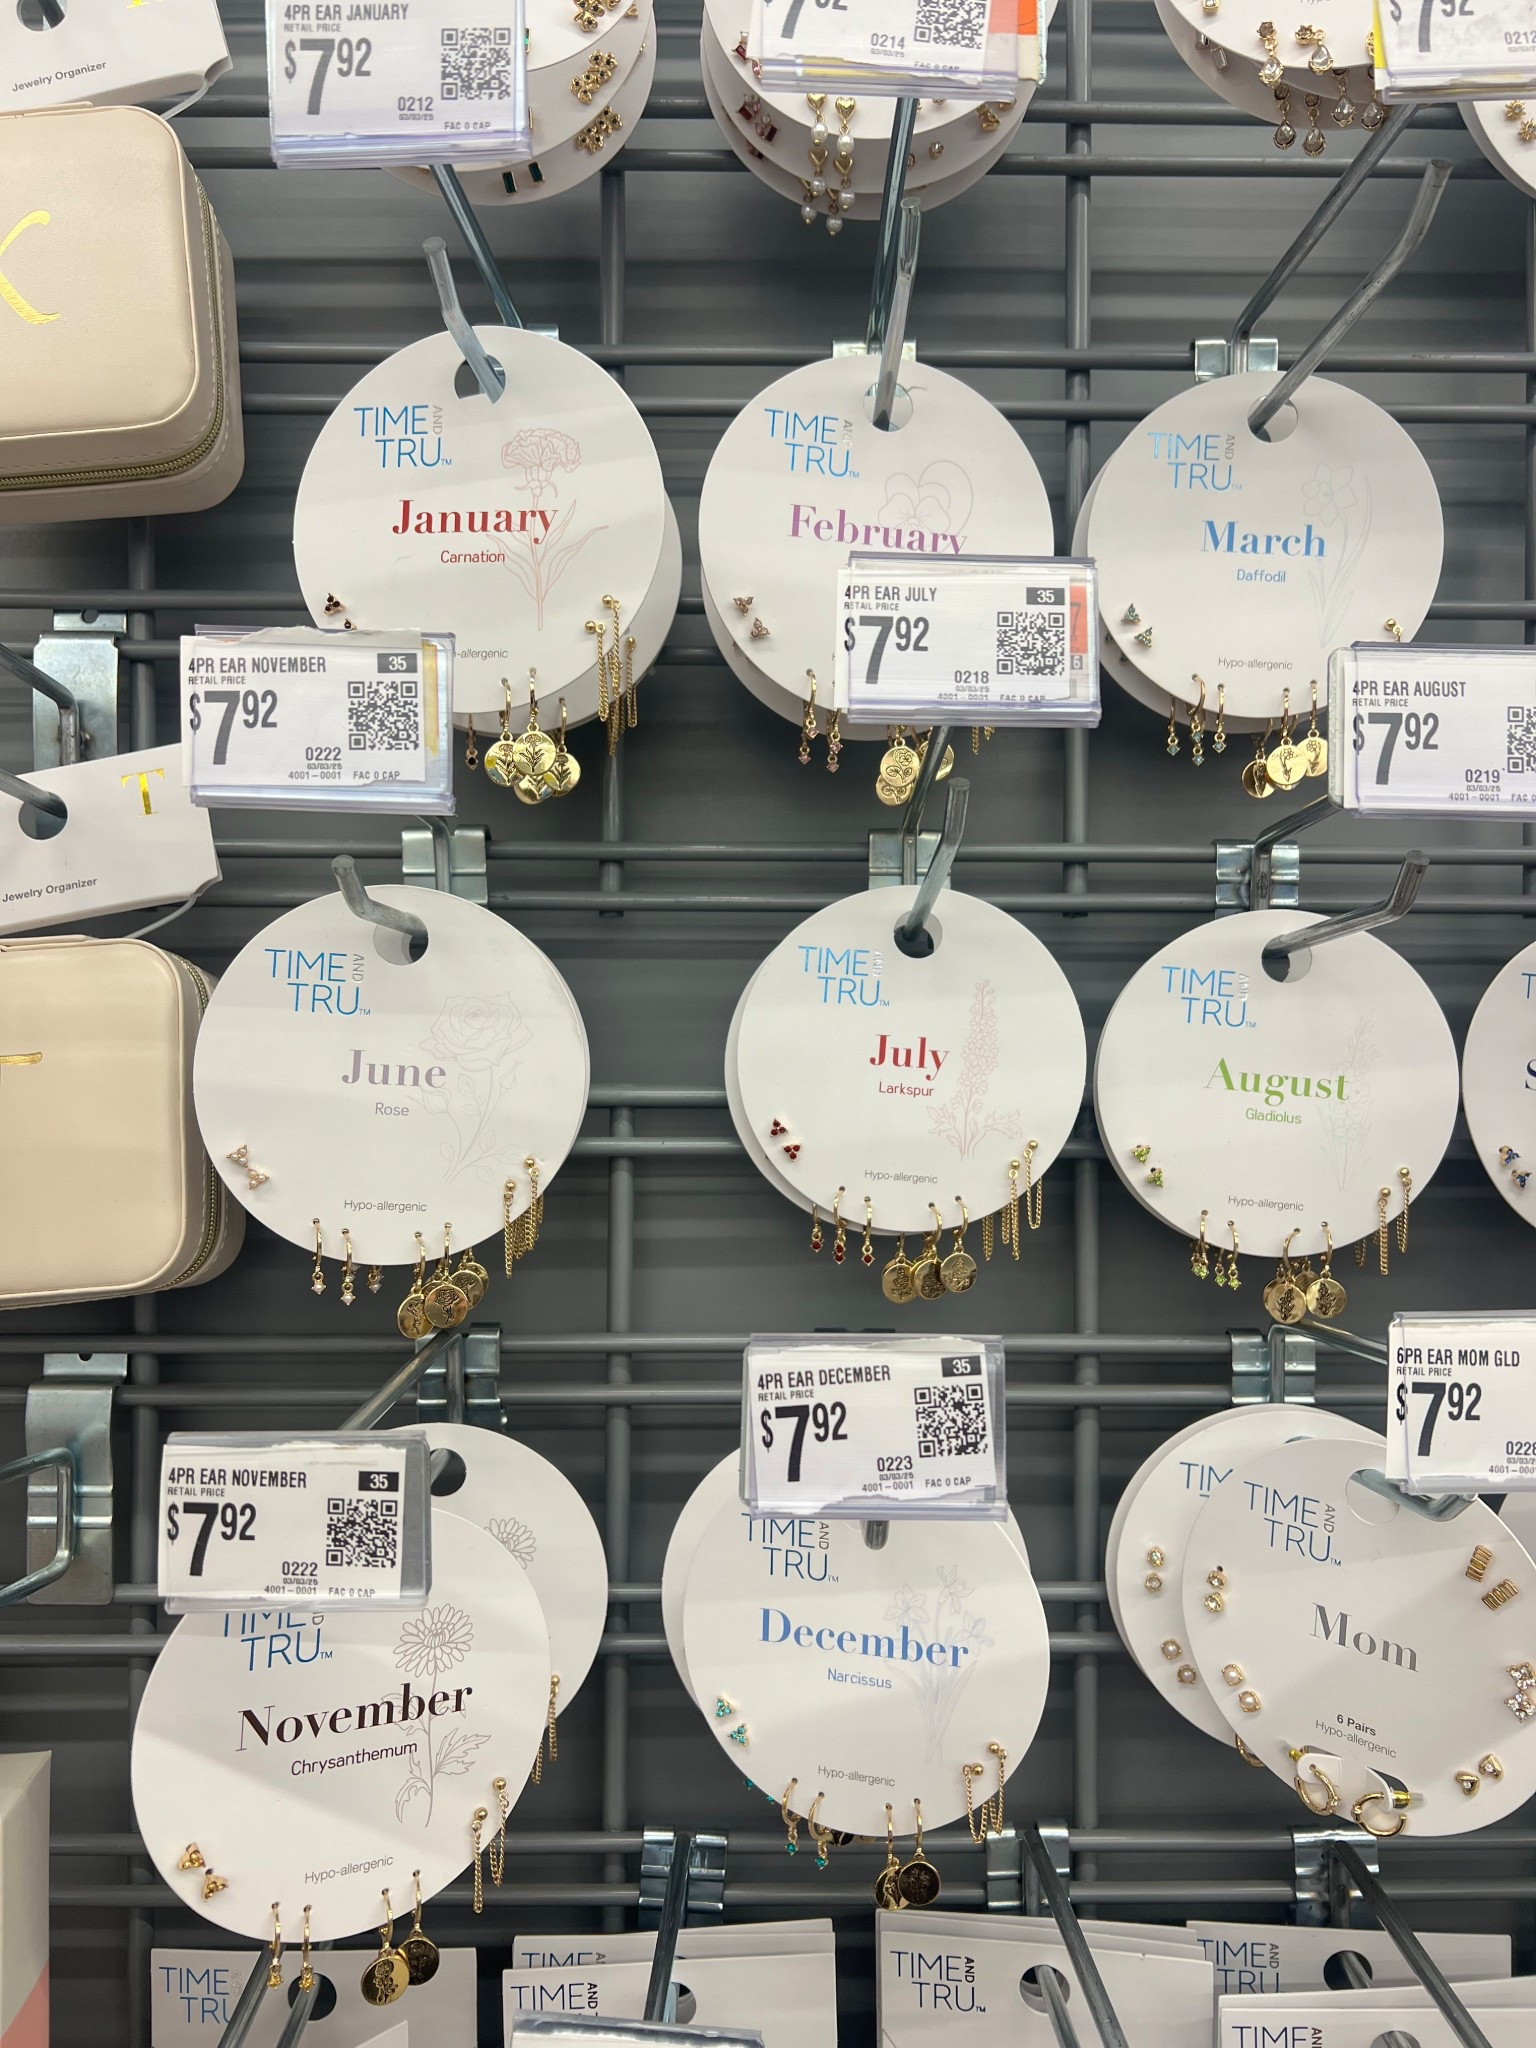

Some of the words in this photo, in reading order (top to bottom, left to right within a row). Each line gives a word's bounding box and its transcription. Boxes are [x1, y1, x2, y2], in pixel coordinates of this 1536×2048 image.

[284, 4, 311, 21] 4PR
[316, 4, 342, 21] EAR
[346, 3, 409, 21] JANUARY
[283, 23, 314, 32] RETAIL
[316, 23, 341, 32] PRICE
[871, 33, 905, 49] 0214
[12, 75, 52, 92] Jewelry
[55, 62, 107, 80] Organizer
[398, 96, 434, 112] 0212
[353, 405, 428, 437] TIME
[432, 405, 443, 435] AND
[764, 408, 839, 445] TIME
[1147, 432, 1221, 461] TIME
[392, 499, 558, 545] January
[1201, 519, 1327, 558] March
[440, 550, 505, 564] Carnation
[1236, 569, 1287, 583] Daffodil
[844, 585, 870, 601] 4PR
[875, 586, 900, 601] EAR
[905, 586, 937, 602] JULY
[1036, 590, 1054, 603] 35
[844, 602, 873, 610] RETAIL
[876, 602, 899, 611] PRICE
[188, 657, 215, 674] 4PR
[220, 657, 246, 674] EAR
[252, 656, 326, 674] NOVEMBER
[388, 656, 407, 670] 35
[1218, 657, 1293, 671] Hypo-allergenic
[188, 676, 218, 685] RETAIL
[221, 676, 246, 685] PRICE
[954, 670, 989, 684] 0218
[1000, 694, 1016, 702] FAC
[1352, 680, 1378, 696] 4PR
[1383, 681, 1409, 696] EAR
[1413, 681, 1466, 697] AUGUST
[1352, 698, 1381, 707] RETAIL
[1384, 698, 1409, 707] PRICE
[305, 747, 342, 761] 0222
[353, 771, 371, 780] FAC
[382, 771, 400, 780] CAP
[1465, 769, 1500, 783] 0219
[121, 768, 165, 819] T
[1511, 794, 1527, 802] FAC
[2, 889, 43, 902] Jewelry
[46, 878, 98, 896] Organizer
[264, 949, 347, 983] TIME
[798, 946, 870, 977] TIME
[1161, 965, 1236, 997] TIME
[870, 1034, 949, 1081] July
[341, 1049, 447, 1089] June
[879, 1081, 935, 1098] Larkspur
[1203, 1057, 1350, 1107] August
[375, 1102, 410, 1116] Rose
[1245, 1108, 1302, 1124] Gladiolus
[864, 1169, 939, 1185] Hypo-allergenic
[344, 1200, 427, 1213] Hypo-allergenic
[1228, 1196, 1304, 1212] Hypo-allergenic
[952, 1359, 971, 1374] 35
[1397, 1347, 1422, 1365] 6PR
[1427, 1348, 1453, 1365] EAR
[1458, 1349, 1489, 1367] MOM
[1494, 1351, 1520, 1367] GLD
[758, 1373, 783, 1390] 4PR
[788, 1370, 814, 1388] EAR
[819, 1365, 891, 1386] DECEMBER
[1396, 1366, 1425, 1376] RETAIL
[1429, 1367, 1452, 1377] PRICE
[758, 1391, 787, 1402] RETAIL
[790, 1389, 815, 1399] PRICE
[877, 1456, 913, 1471] 0223
[168, 1468, 195, 1484] 4PR
[200, 1468, 227, 1486] EAR
[232, 1469, 307, 1488] NOVEMBER
[369, 1474, 388, 1489] 35
[925, 1479, 942, 1488] FAC
[954, 1476, 972, 1486] CAP
[1179, 1461, 1234, 1492] TIM
[168, 1487, 197, 1496] RETAIL
[201, 1488, 225, 1497] PRICE
[1244, 1481, 1320, 1529] TIME
[741, 1513, 815, 1548] TIME
[282, 1561, 318, 1577] 0222
[329, 1587, 345, 1597] FAC
[358, 1588, 375, 1598] CAP
[759, 1607, 969, 1668] December
[1310, 1602, 1420, 1673] Mom
[827, 1667, 892, 1689] Narcissus
[235, 1682, 473, 1752] November
[1336, 1714, 1345, 1725] 6
[1347, 1715, 1377, 1737] Pairs
[1315, 1719, 1397, 1759] Hypo-allergenic
[290, 1740, 418, 1776] Chrysanthemum
[817, 1765, 896, 1787] Hypo-allergenic
[304, 1855, 394, 1885] Hypo-allergenic
[1197, 1939, 1267, 1968] TIME
[1269, 1943, 1279, 1969] AND
[890, 1951, 962, 1982] TIME
[158, 1966, 230, 1996] TIME
[511, 1983, 585, 2010] TIME
[587, 1983, 598, 2009] AND
